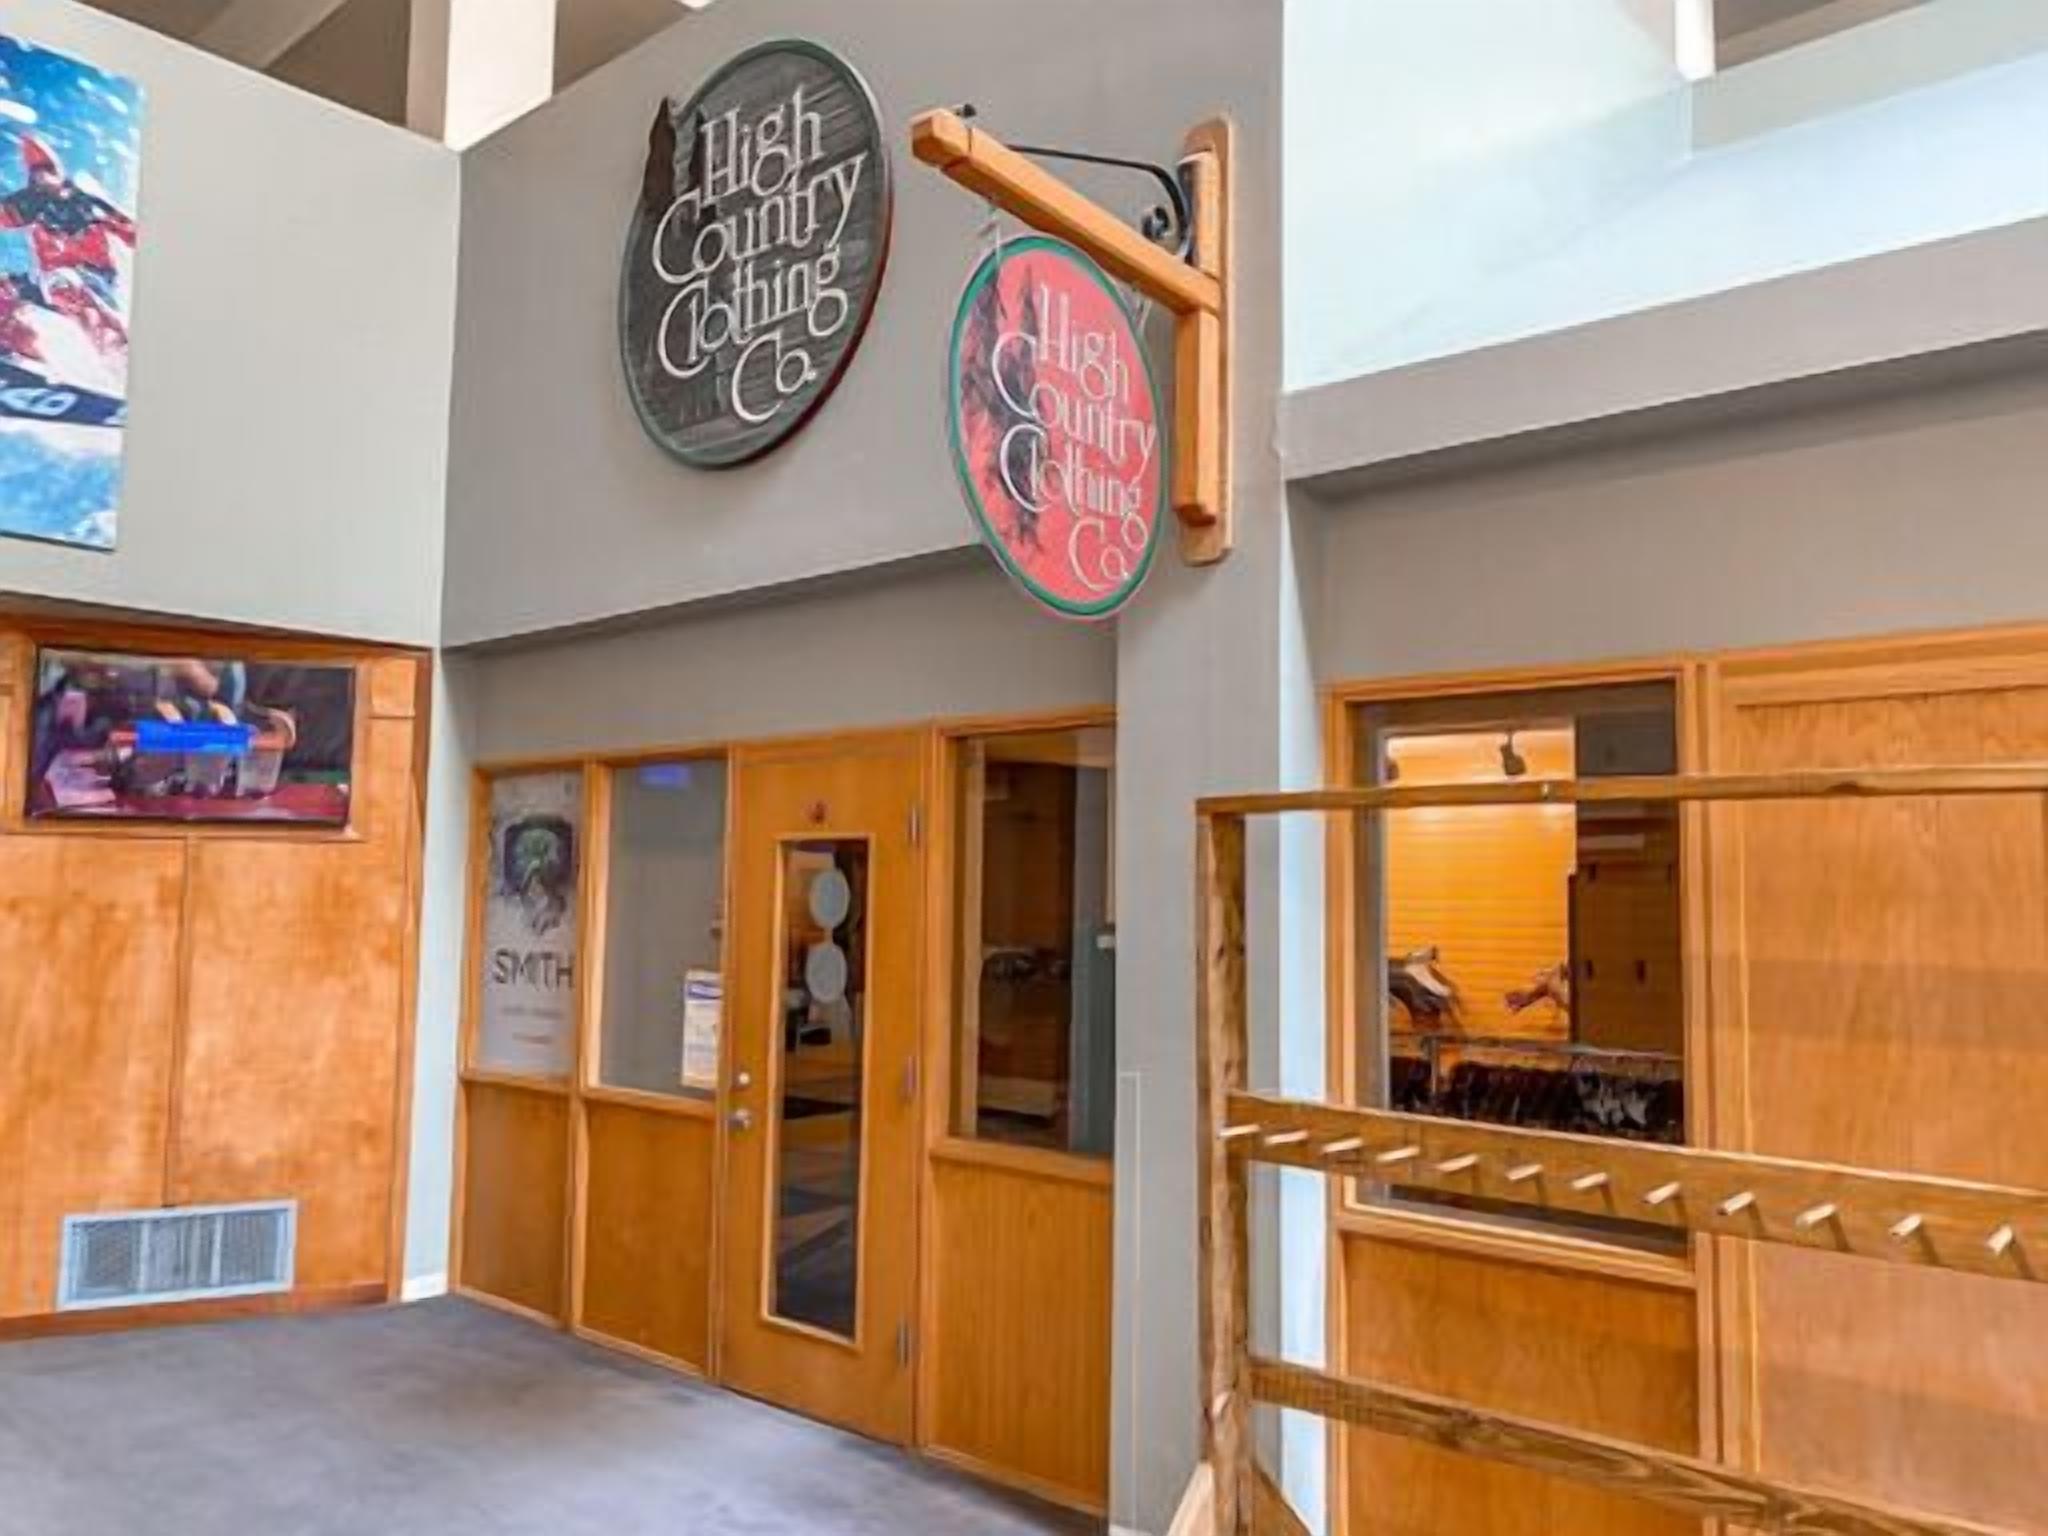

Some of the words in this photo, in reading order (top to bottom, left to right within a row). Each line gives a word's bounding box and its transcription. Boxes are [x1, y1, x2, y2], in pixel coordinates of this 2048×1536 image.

[701, 85, 824, 207] High
[652, 153, 867, 284] Country
[657, 242, 849, 379] Clothing
[1038, 283, 1129, 403] High
[731, 330, 816, 423] Co.
[992, 331, 1157, 486] Country
[1001, 424, 1149, 551] Clothing
